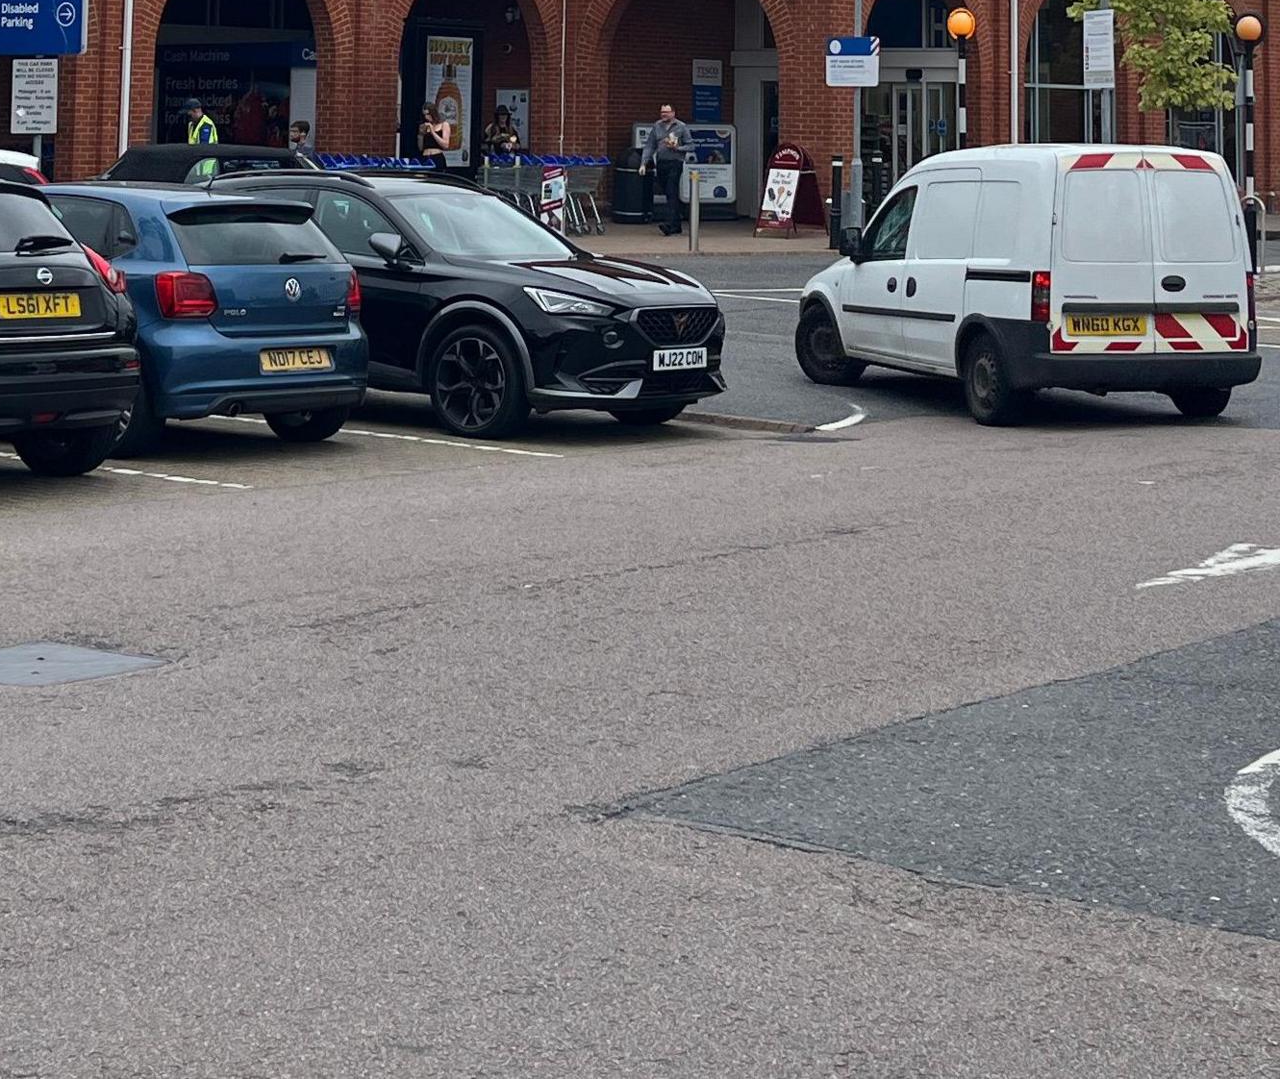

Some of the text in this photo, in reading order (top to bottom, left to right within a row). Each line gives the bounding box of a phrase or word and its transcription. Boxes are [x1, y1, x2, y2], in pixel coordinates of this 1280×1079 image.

[1, 2, 39, 14] Disabled
[1, 16, 34, 30] Parking
[163, 49, 231, 62] Cash Machine
[165, 75, 238, 89] Fresh berries
[6, 295, 70, 315] LS61 XFT
[224, 308, 247, 316] POLO
[1112, 317, 1141, 332] KGX
[268, 348, 322, 368] ND17 CEJ
[685, 350, 704, 366] COH
